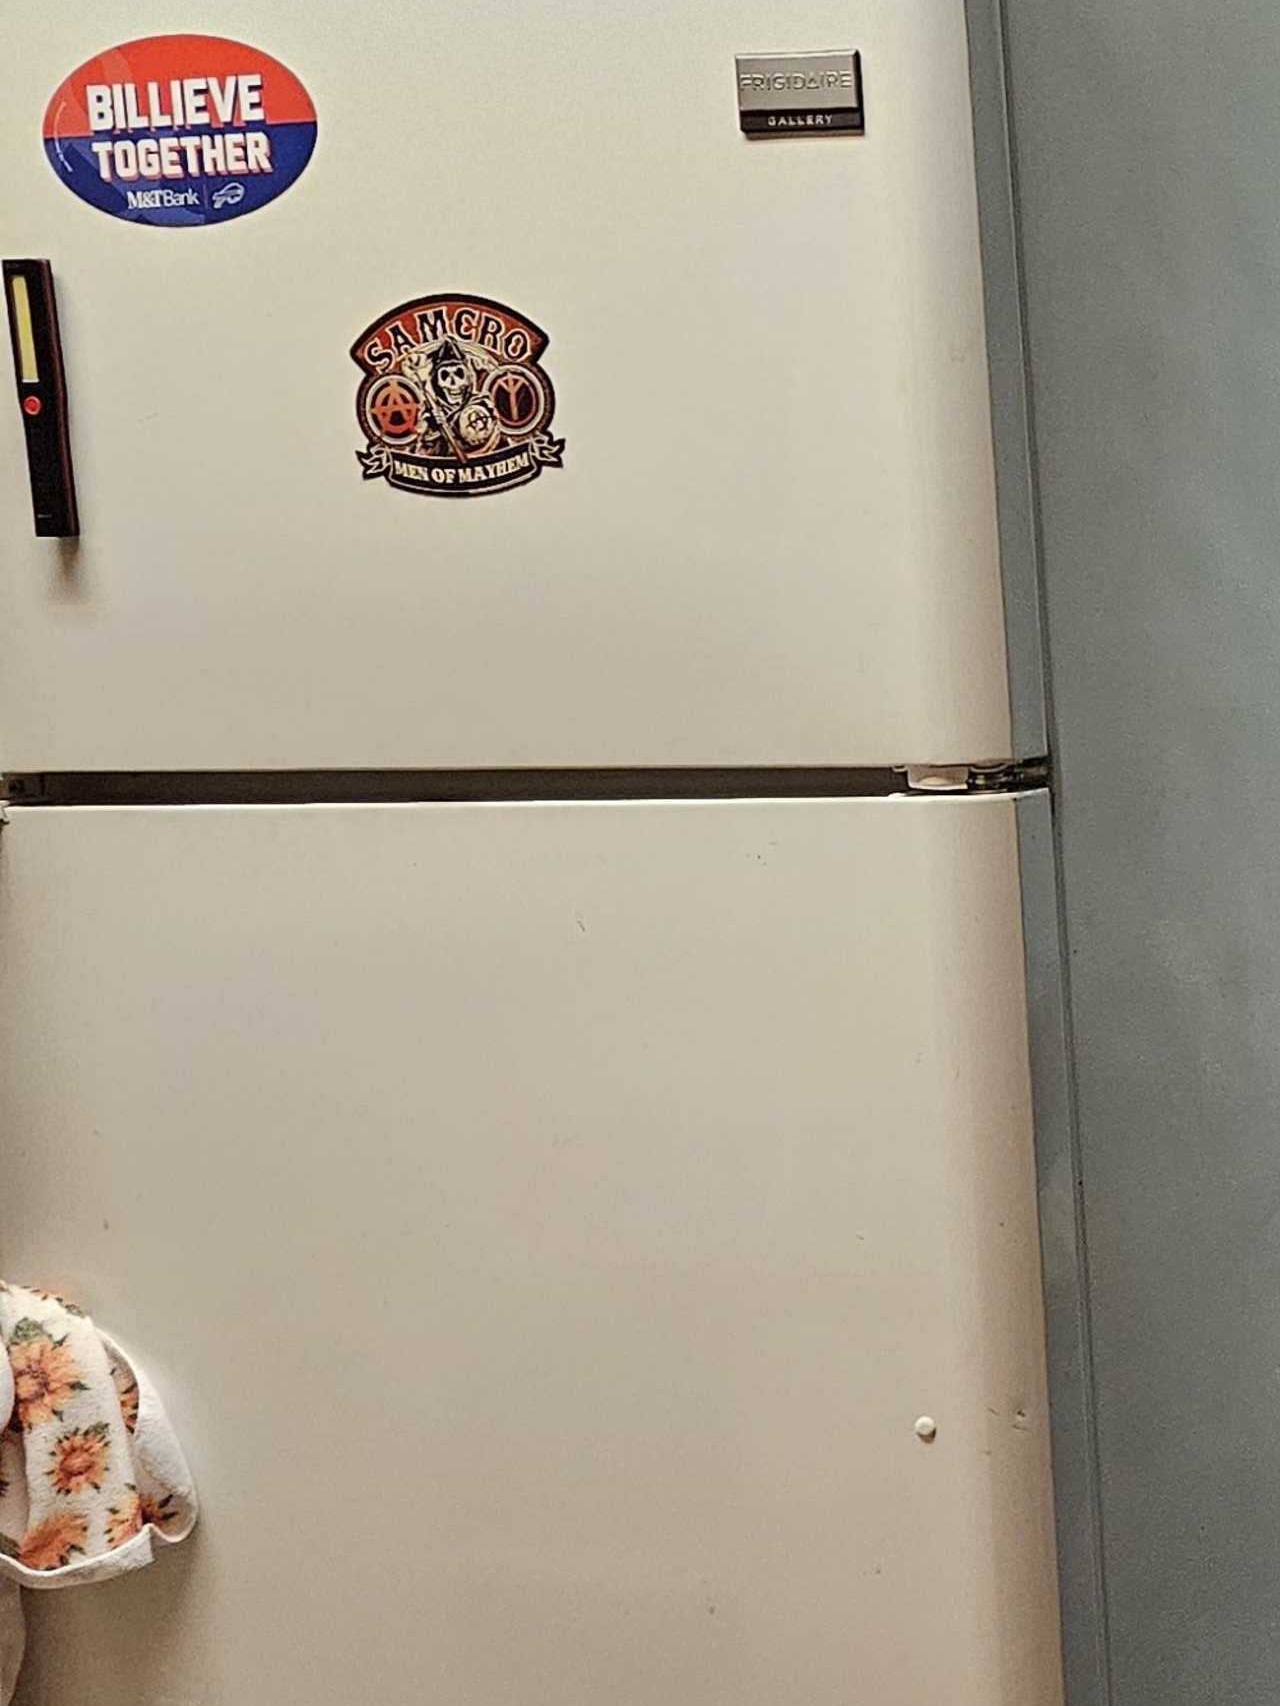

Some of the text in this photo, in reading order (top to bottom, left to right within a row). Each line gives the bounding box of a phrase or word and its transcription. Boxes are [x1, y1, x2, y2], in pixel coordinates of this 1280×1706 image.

[740, 70, 853, 92] FRIGIDAIRE
[86, 73, 265, 131] BILLIEVE
[768, 115, 833, 127] GALLERY
[92, 132, 273, 181] TOGETHER
[366, 307, 532, 374] SAMCRO
[394, 453, 530, 484] MEN OF MAYHEM
